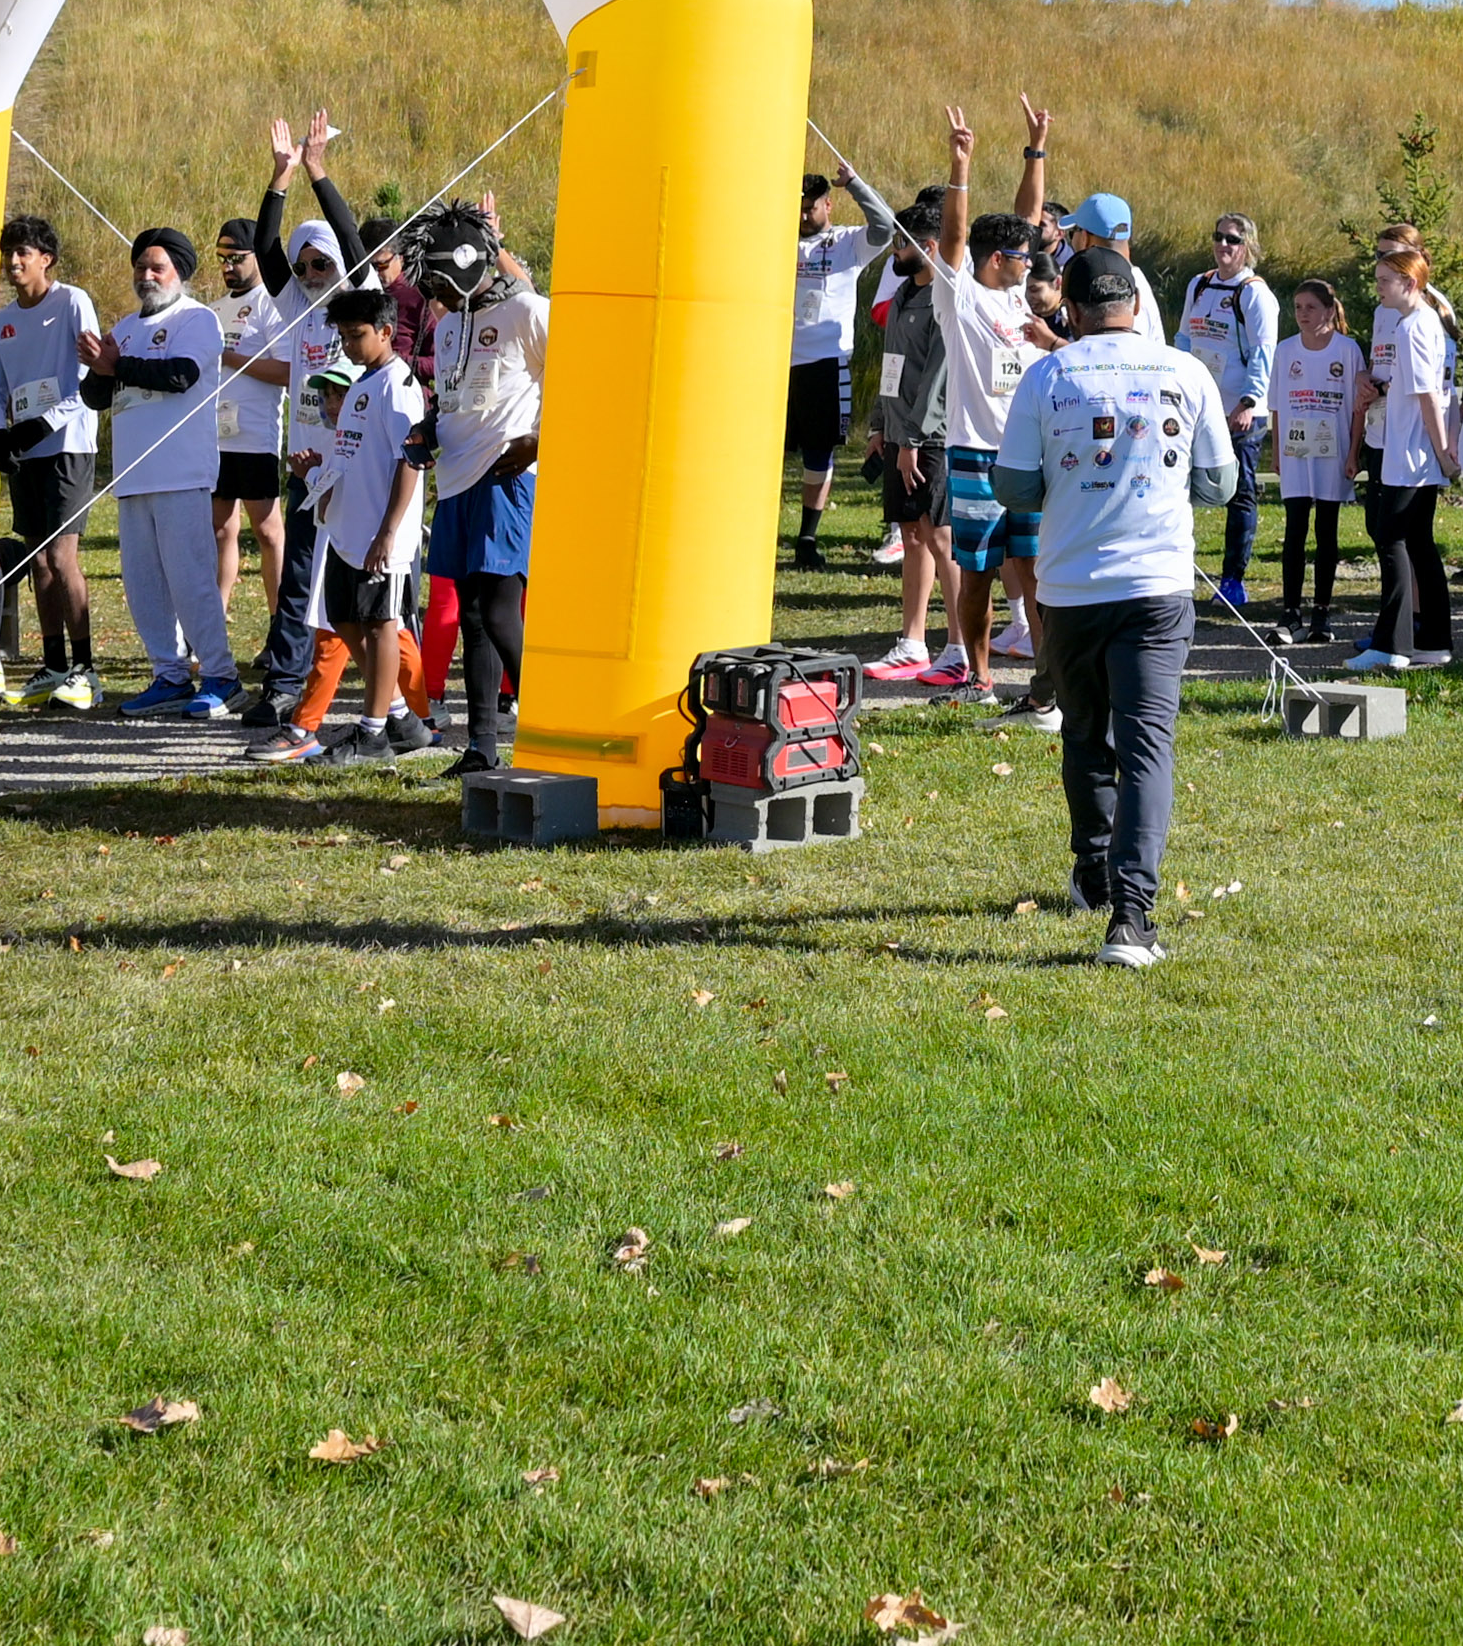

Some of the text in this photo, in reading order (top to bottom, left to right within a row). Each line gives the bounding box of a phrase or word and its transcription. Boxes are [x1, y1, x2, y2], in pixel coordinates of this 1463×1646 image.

[1001, 362, 1022, 375] 129
[300, 392, 319, 407] 066
[1315, 390, 1344, 399] TOGETHER
[1051, 395, 1080, 412] infini
[1288, 429, 1306, 441] 024
